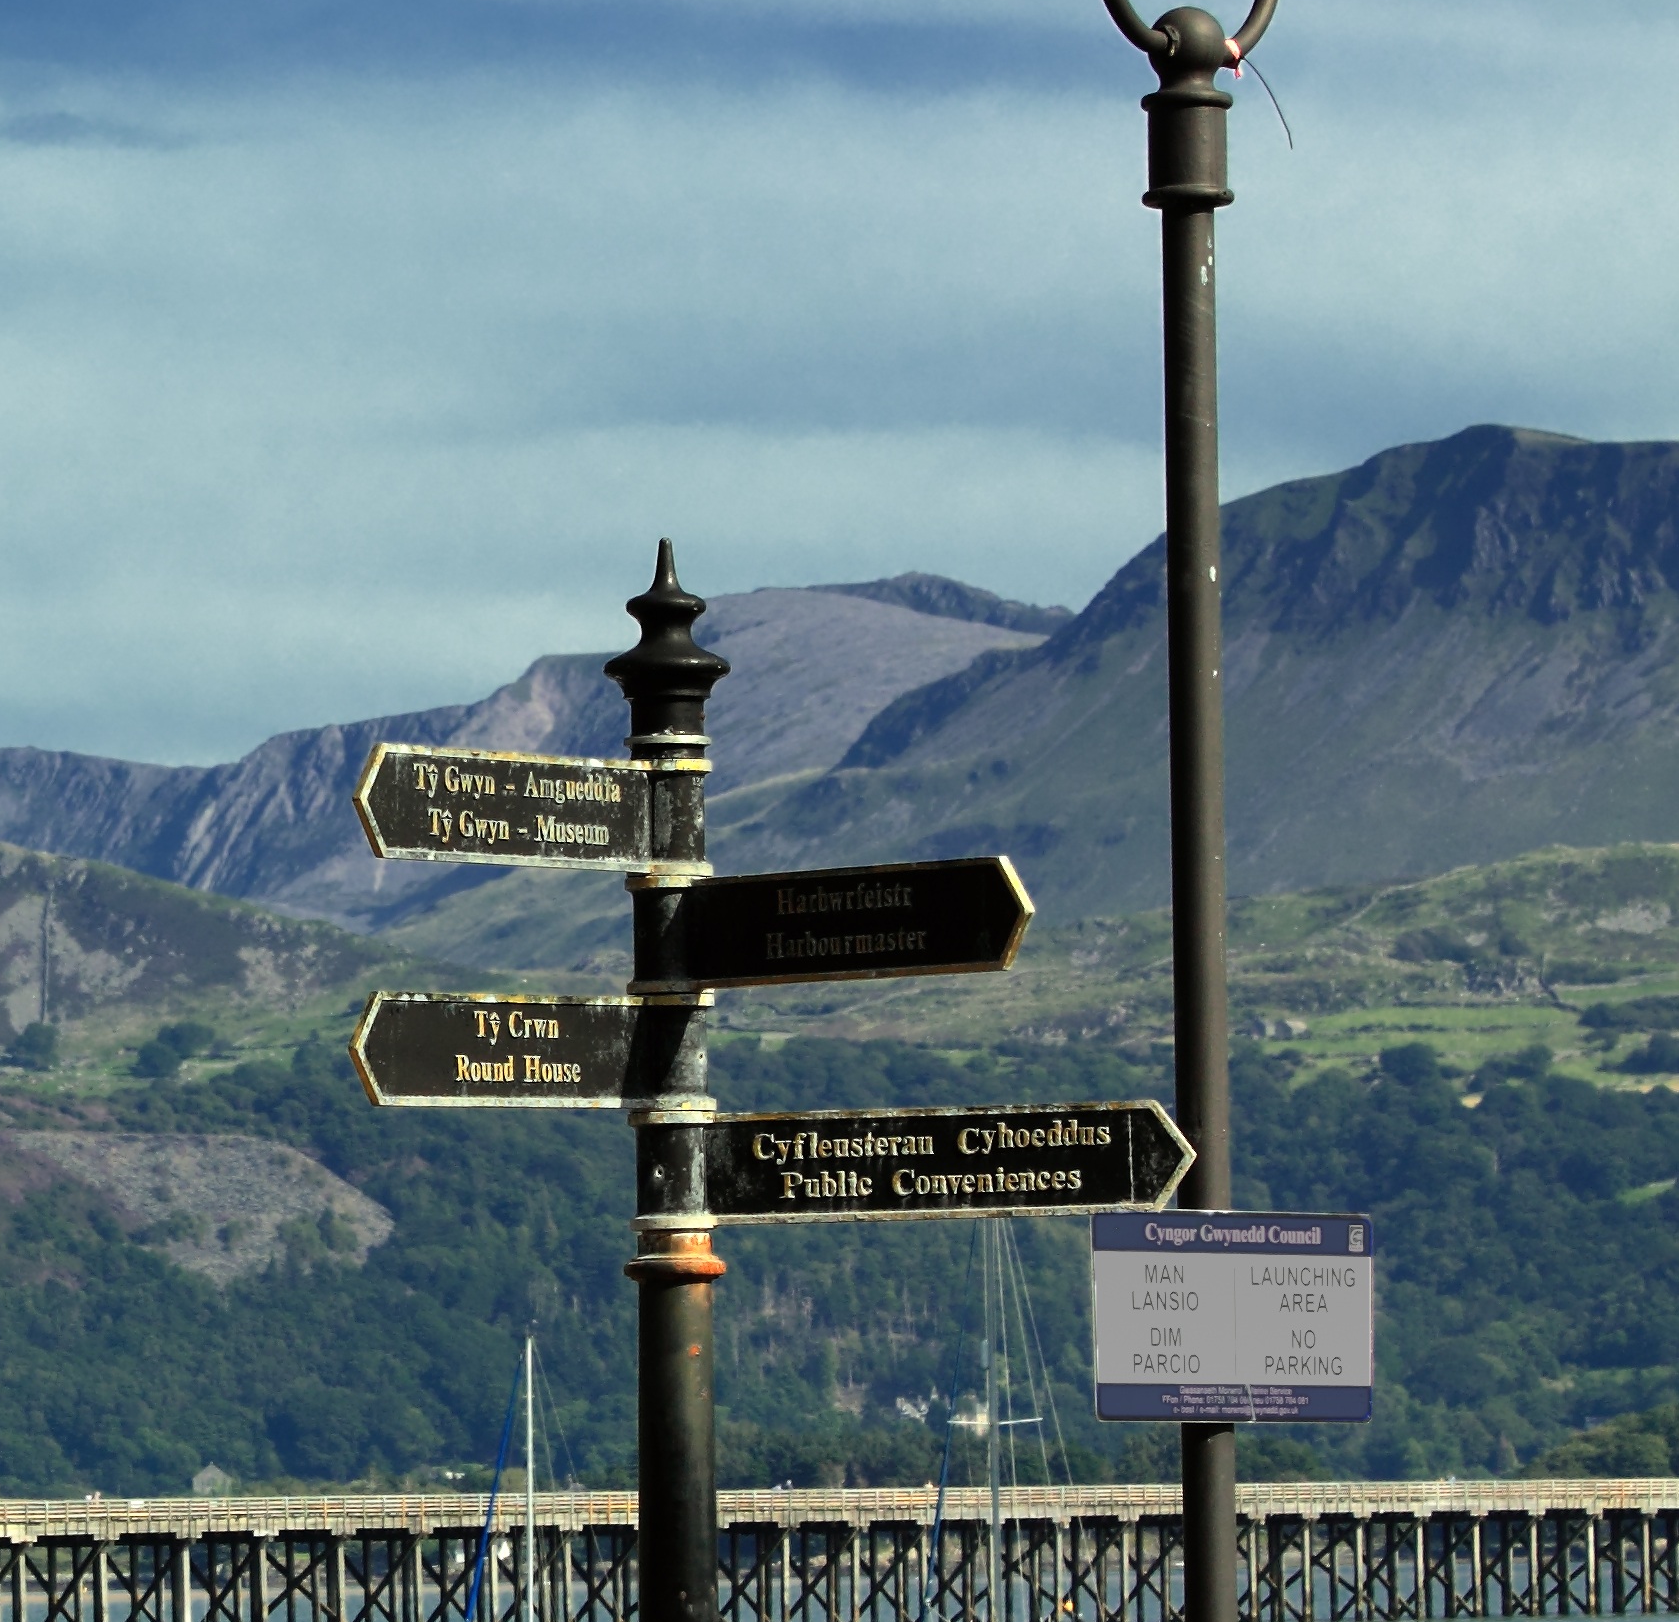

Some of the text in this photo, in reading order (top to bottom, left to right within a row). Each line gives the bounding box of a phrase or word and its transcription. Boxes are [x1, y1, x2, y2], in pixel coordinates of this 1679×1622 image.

[413, 763, 439, 798] Tŷ
[444, 765, 496, 800] Gwyn
[523, 771, 622, 804] Amgueddfa
[427, 807, 453, 843] Tŷ
[459, 810, 510, 845] Gwyn
[533, 814, 610, 846] Museum
[776, 882, 913, 915] Harbwrfeistr
[765, 927, 927, 960] Harbourmaster
[473, 1010, 559, 1046] Tŷ Crwn
[455, 1054, 582, 1083] Round House
[752, 1119, 1112, 1166] Cyfleusterau Cyhoeddus
[778, 1167, 1082, 1199] Public Conveniences
[1144, 1222, 1321, 1247] Cyngor Gwynedd Council
[1144, 1264, 1185, 1284] MAN
[1250, 1266, 1356, 1287] LAUNCHING
[1131, 1291, 1200, 1311] LANSIO
[1279, 1293, 1329, 1313] AREA
[1150, 1327, 1182, 1347] DIM
[1291, 1329, 1316, 1349] NO
[1133, 1353, 1201, 1374] PARCIO
[1264, 1355, 1343, 1376] PARKING
